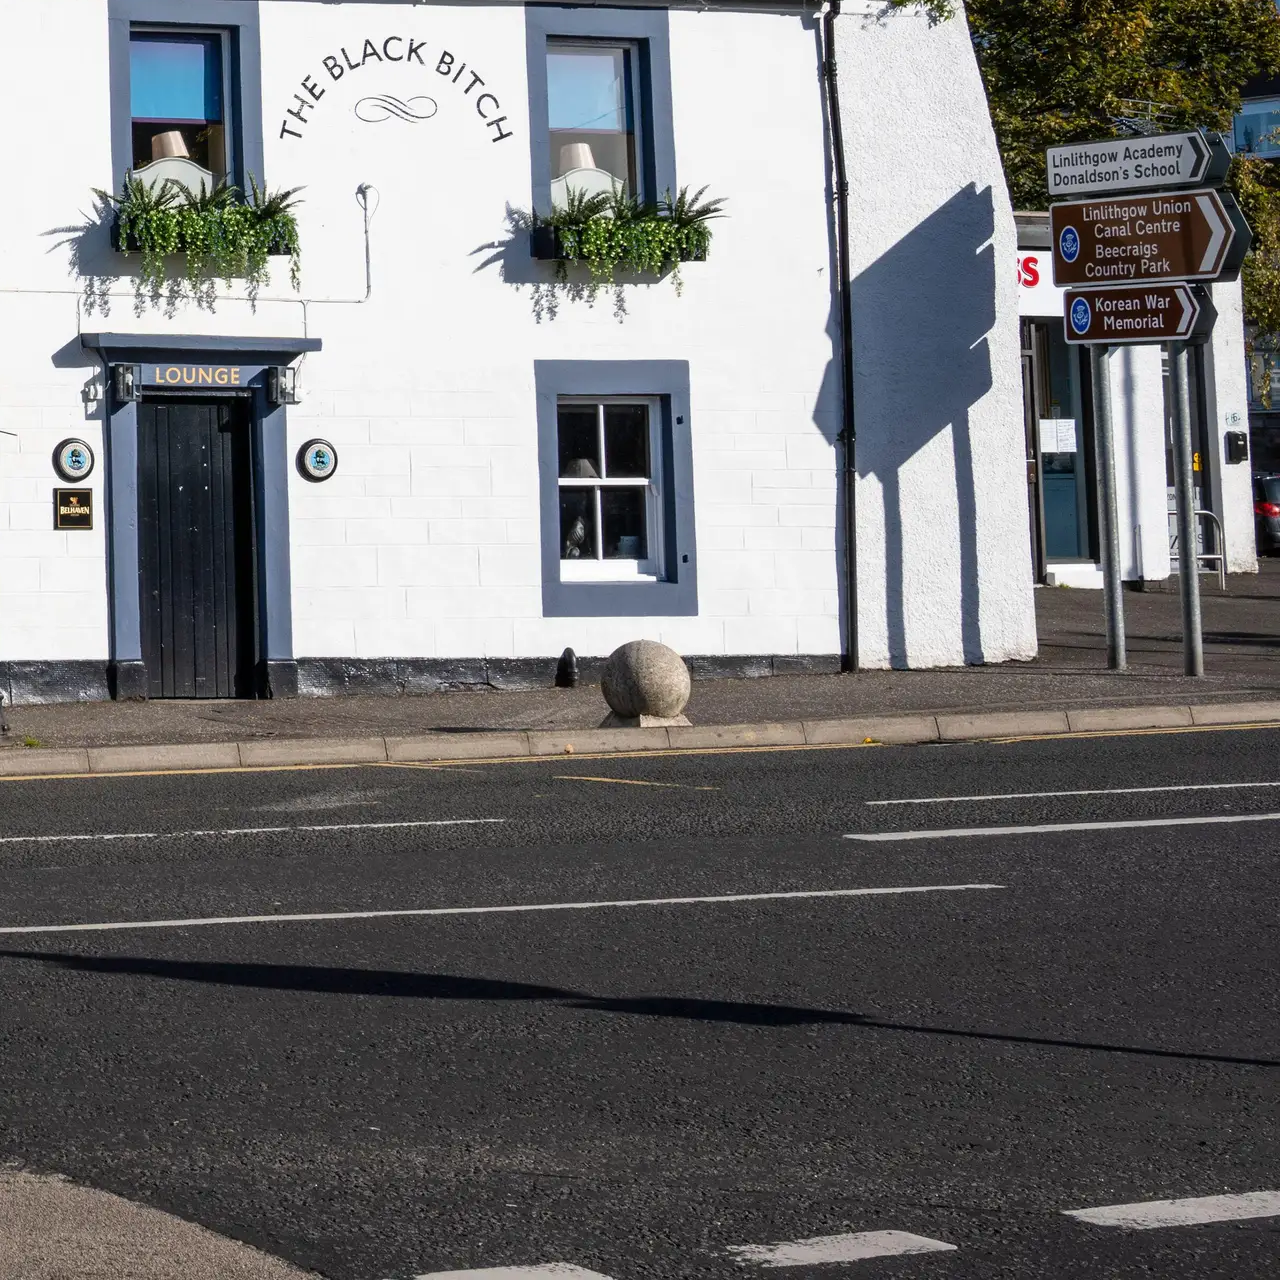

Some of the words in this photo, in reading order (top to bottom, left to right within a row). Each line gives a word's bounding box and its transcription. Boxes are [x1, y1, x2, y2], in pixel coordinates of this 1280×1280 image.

[279, 74, 325, 139] THE
[321, 35, 428, 81] BLACK
[435, 50, 514, 143] BITCH
[1053, 151, 1118, 168] Linlithgow
[1123, 144, 1183, 161] Academy
[1053, 165, 1129, 186] Donaldson's
[1134, 160, 1180, 178] School
[1083, 205, 1148, 221] Linlithgow
[1152, 200, 1191, 216] Union
[1094, 222, 1131, 238] Canal
[1135, 219, 1180, 235] Centre
[1095, 242, 1158, 259] Beecraigs
[1085, 261, 1136, 277] Country
[1141, 258, 1171, 274] Park
[1095, 298, 1141, 312] Korean
[1145, 295, 1170, 309] War
[1103, 314, 1164, 330] Memorial
[155, 367, 241, 385] LOUNGE
[60, 506, 90, 514] BELHAVEN
